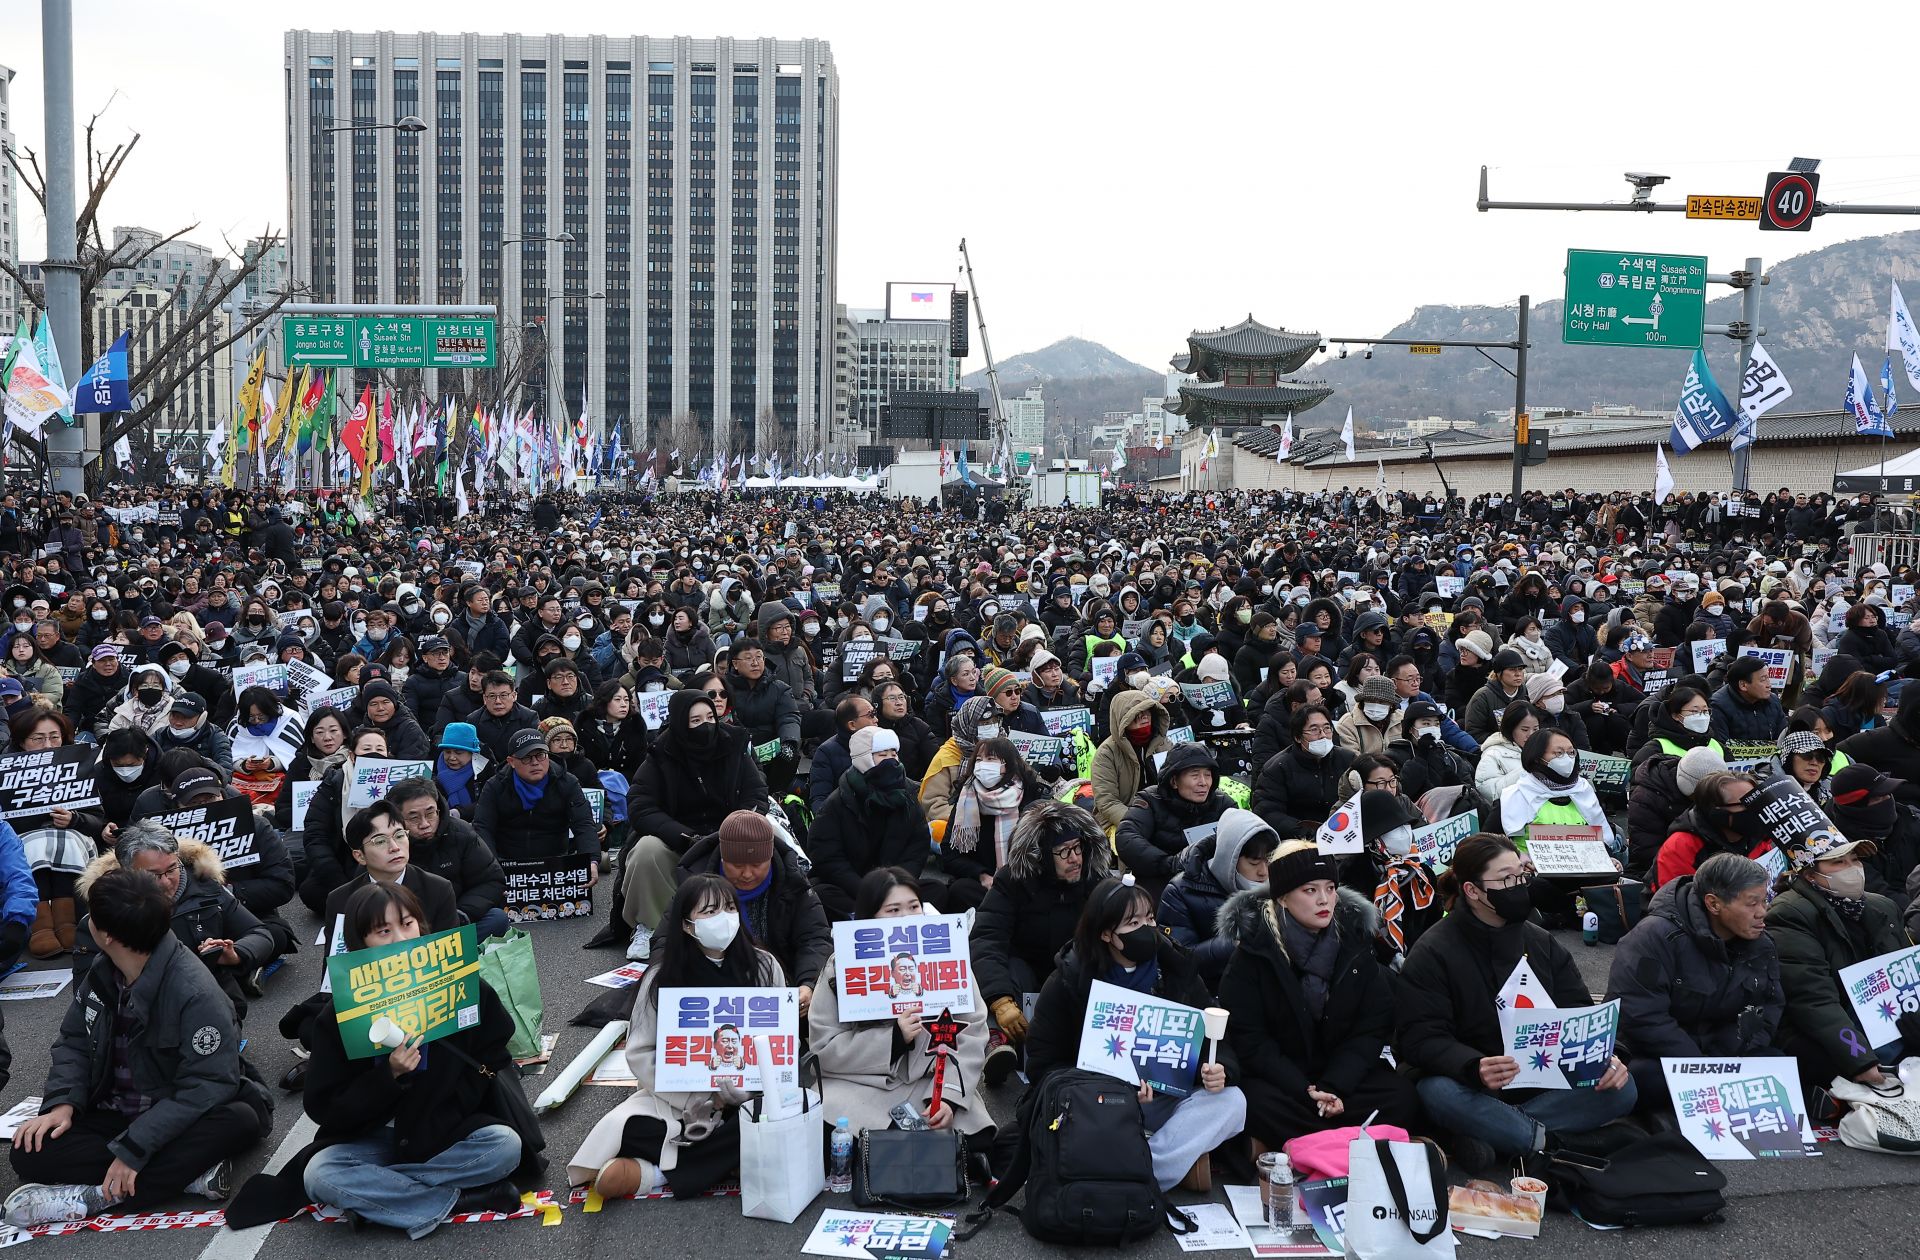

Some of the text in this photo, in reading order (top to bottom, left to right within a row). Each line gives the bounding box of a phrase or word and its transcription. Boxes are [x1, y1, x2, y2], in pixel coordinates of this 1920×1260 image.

[1690, 200, 1759, 217] 과속단속장비
[1778, 190, 1803, 214] 40
[1618, 257, 1657, 273] 수색역
[1660, 264, 1702, 275] Susaek Stn
[1601, 276, 1613, 286] 21
[1617, 275, 1657, 290] 독립문
[1660, 274, 1687, 285] 獨立門
[1660, 285, 1702, 295] Dongnimmun
[1570, 303, 1618, 318] 시청 市廳
[1651, 305, 1662, 314] 50
[294, 324, 345, 336] 종로구청
[374, 323, 411, 333] 수색역
[437, 325, 484, 336] 삼청터널
[1570, 320, 1610, 331] City Hall
[295, 340, 317, 349] Jongno
[319, 340, 331, 348] Dist
[1645, 332, 1667, 342] 100m
[373, 345, 396, 354] 광화문
[845, 642, 875, 651] 윤석열을
[255, 665, 283, 681] 체포!
[330, 687, 357, 705] 체포!
[1201, 682, 1229, 695] 체포!
[1205, 693, 1231, 705] 구속!
[1060, 709, 1086, 728] 체포!
[1030, 739, 1059, 753] 체포!
[0, 751, 55, 772] 윤석열을
[1026, 753, 1056, 766] 구속!
[1597, 760, 1632, 772] 체포!
[0, 761, 80, 791] 파면하고
[359, 767, 388, 775] 내란수괴
[1593, 773, 1627, 785] 구속!
[178, 775, 214, 790] TaylorMade
[357, 774, 387, 785] 윤석열
[11, 778, 95, 808] 구속하라!
[171, 817, 238, 844] 면하고
[1437, 816, 1472, 845] 해체
[1771, 811, 1820, 846] 법대로
[505, 867, 588, 888] 내란수괴 윤석열
[504, 888, 541, 903] 법대로
[854, 923, 951, 960] 윤석열
[350, 931, 465, 1004] 생명안전
[845, 959, 968, 997] 즉각 체포!
[1851, 968, 1887, 995] 내란동조
[1855, 980, 1891, 1005] 국민의힘
[678, 996, 779, 1028] 윤석열
[1094, 1001, 1137, 1016] 내란수괴
[930, 1023, 958, 1033] 윤석열
[1091, 1014, 1134, 1032] 윤석열
[1136, 1005, 1199, 1039] 체포!
[1516, 1020, 1562, 1035] 내란수괴
[1562, 1004, 1614, 1044] 체포!
[935, 1033, 953, 1042] 파면
[1513, 1032, 1560, 1050] 윤석열
[665, 1035, 713, 1067] 즉각
[1132, 1037, 1192, 1070] 구속!
[1559, 1033, 1611, 1072] 구속!
[1678, 1085, 1718, 1102] 내란수괴
[1720, 1076, 1780, 1110] 체포!
[1682, 1097, 1721, 1118] 윤석열
[1729, 1105, 1789, 1141] 구속!
[131, 1215, 195, 1226] 안전제일
[875, 1219, 938, 1235] 즉각
[822, 1225, 871, 1233] 윤석열
[865, 1234, 931, 1251] 파면
